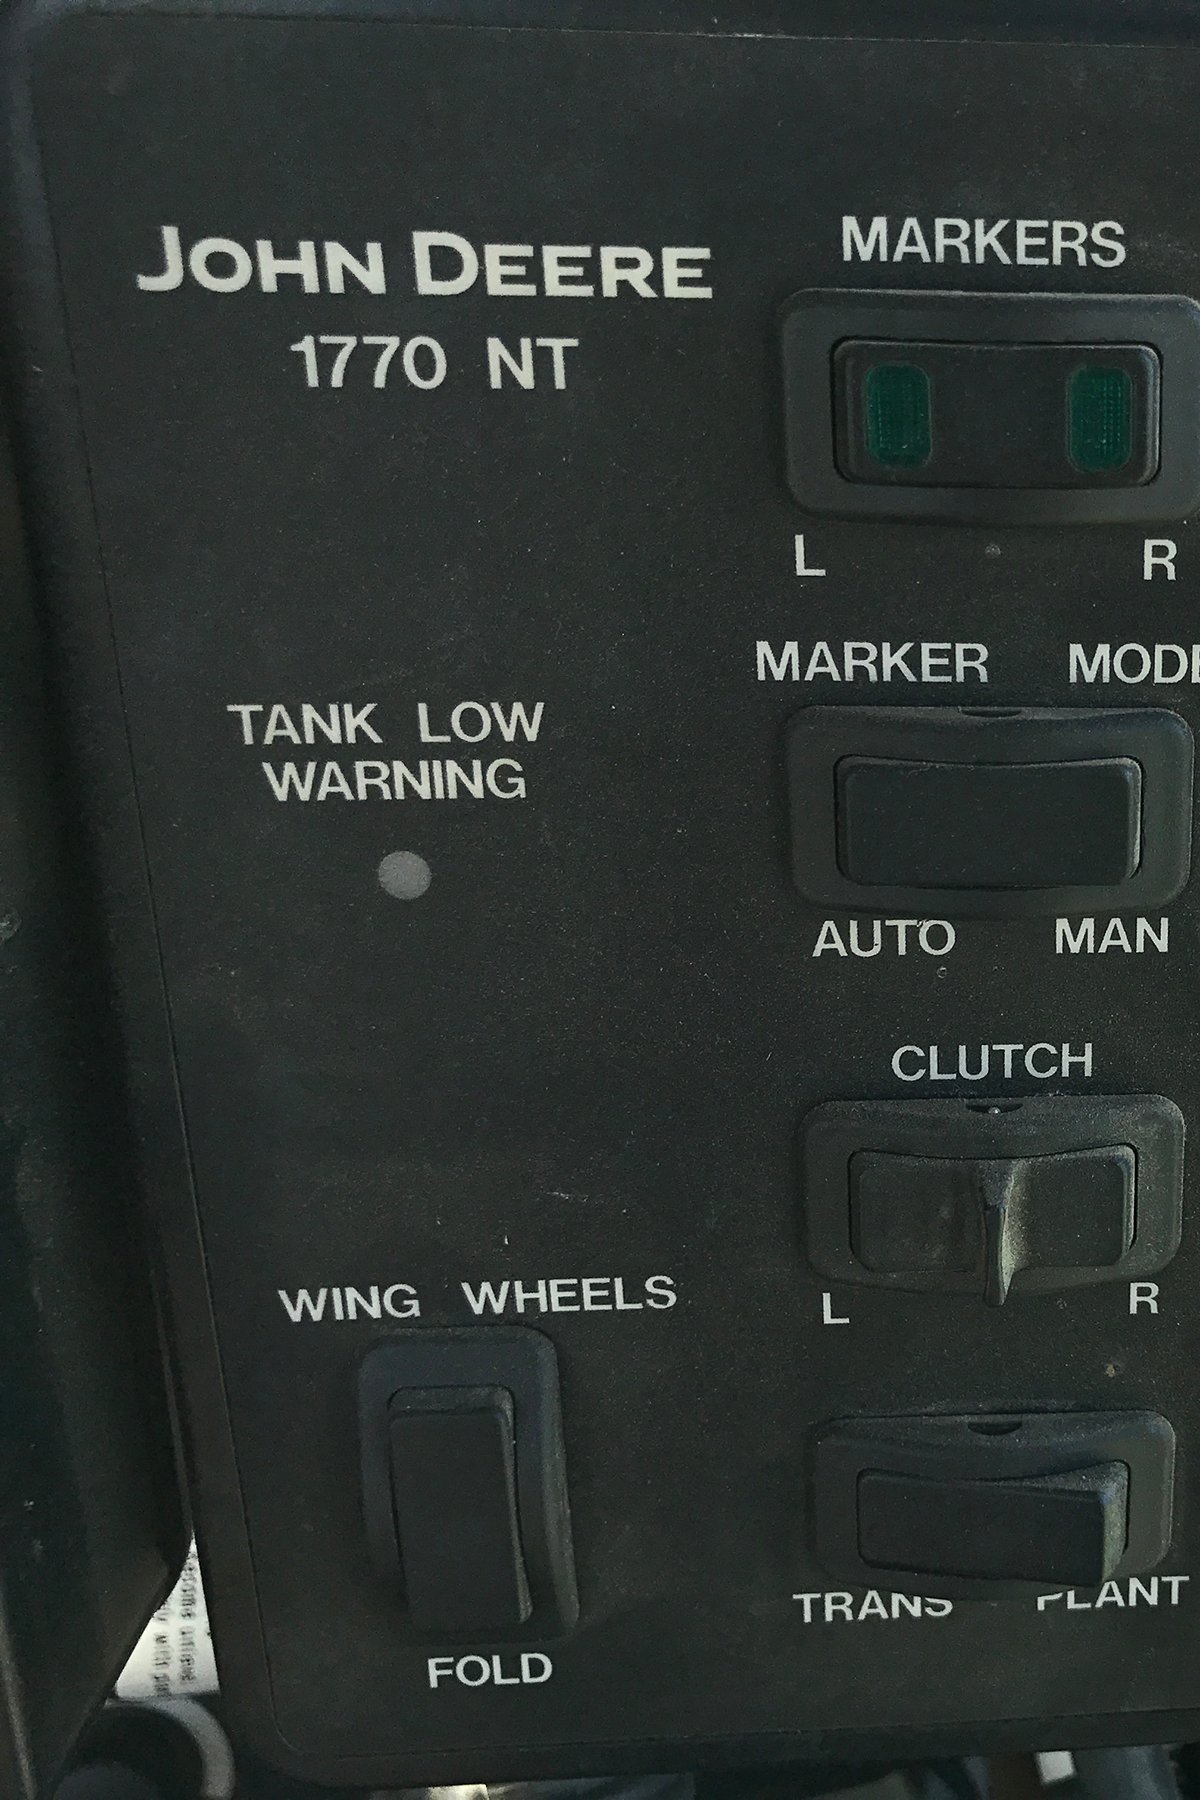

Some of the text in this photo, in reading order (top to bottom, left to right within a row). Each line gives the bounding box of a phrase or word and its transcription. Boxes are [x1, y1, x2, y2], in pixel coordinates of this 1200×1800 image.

[136, 225, 713, 299] JOHN DEERE
[842, 215, 1127, 268] MARKERS
[290, 334, 580, 390] 1770 NT
[794, 534, 826, 577] L
[1143, 538, 1178, 581] R
[755, 640, 989, 683] MARKER
[226, 701, 545, 746] TANK LOW
[261, 757, 527, 802] WARNING
[812, 919, 956, 958] AUTO
[1055, 917, 1169, 954] MAN
[891, 1042, 1093, 1082] CLUTCH
[277, 1275, 677, 1323] WING WHEELS
[822, 1292, 850, 1325] L
[1129, 1282, 1159, 1315] R
[792, 1590, 954, 1623] TRANS
[427, 1652, 553, 1689] FOLD
